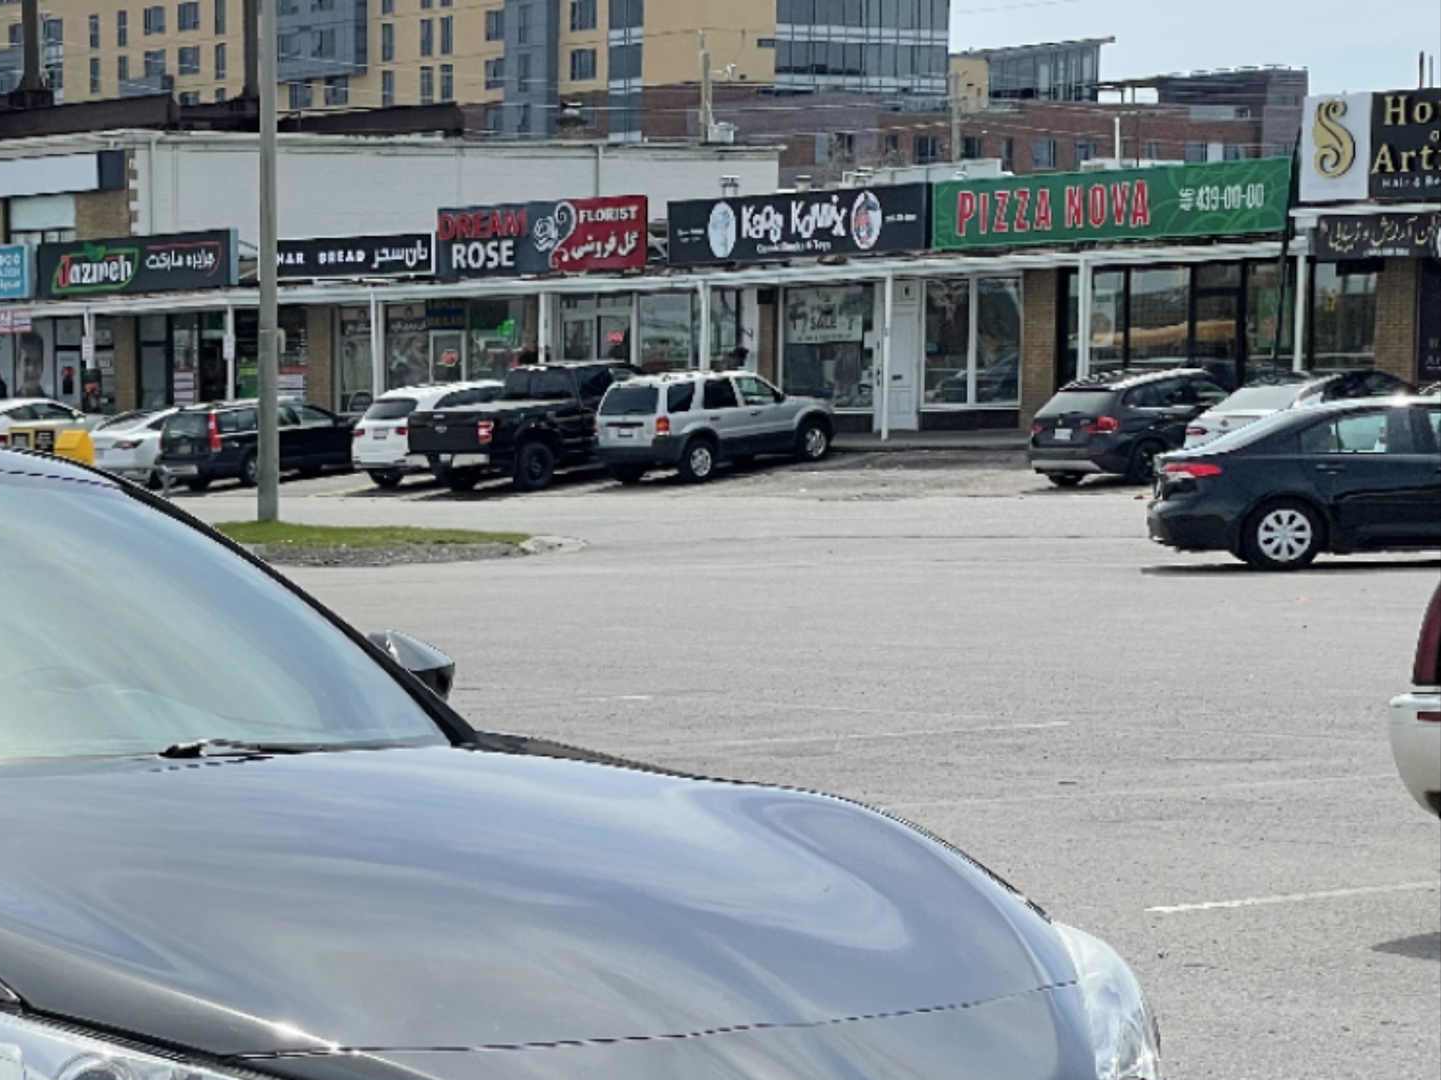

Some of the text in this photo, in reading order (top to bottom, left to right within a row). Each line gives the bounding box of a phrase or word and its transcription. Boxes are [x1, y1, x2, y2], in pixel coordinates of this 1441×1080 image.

[1384, 94, 1441, 126] Ho
[1370, 143, 1441, 175] Art
[579, 206, 639, 224] FLORIST
[955, 187, 1052, 237] PIZZA
[1064, 178, 1151, 229] NOVA
[438, 208, 528, 241] DREAM
[276, 249, 366, 265] HAR BREAD
[451, 240, 515, 270] ROSE
